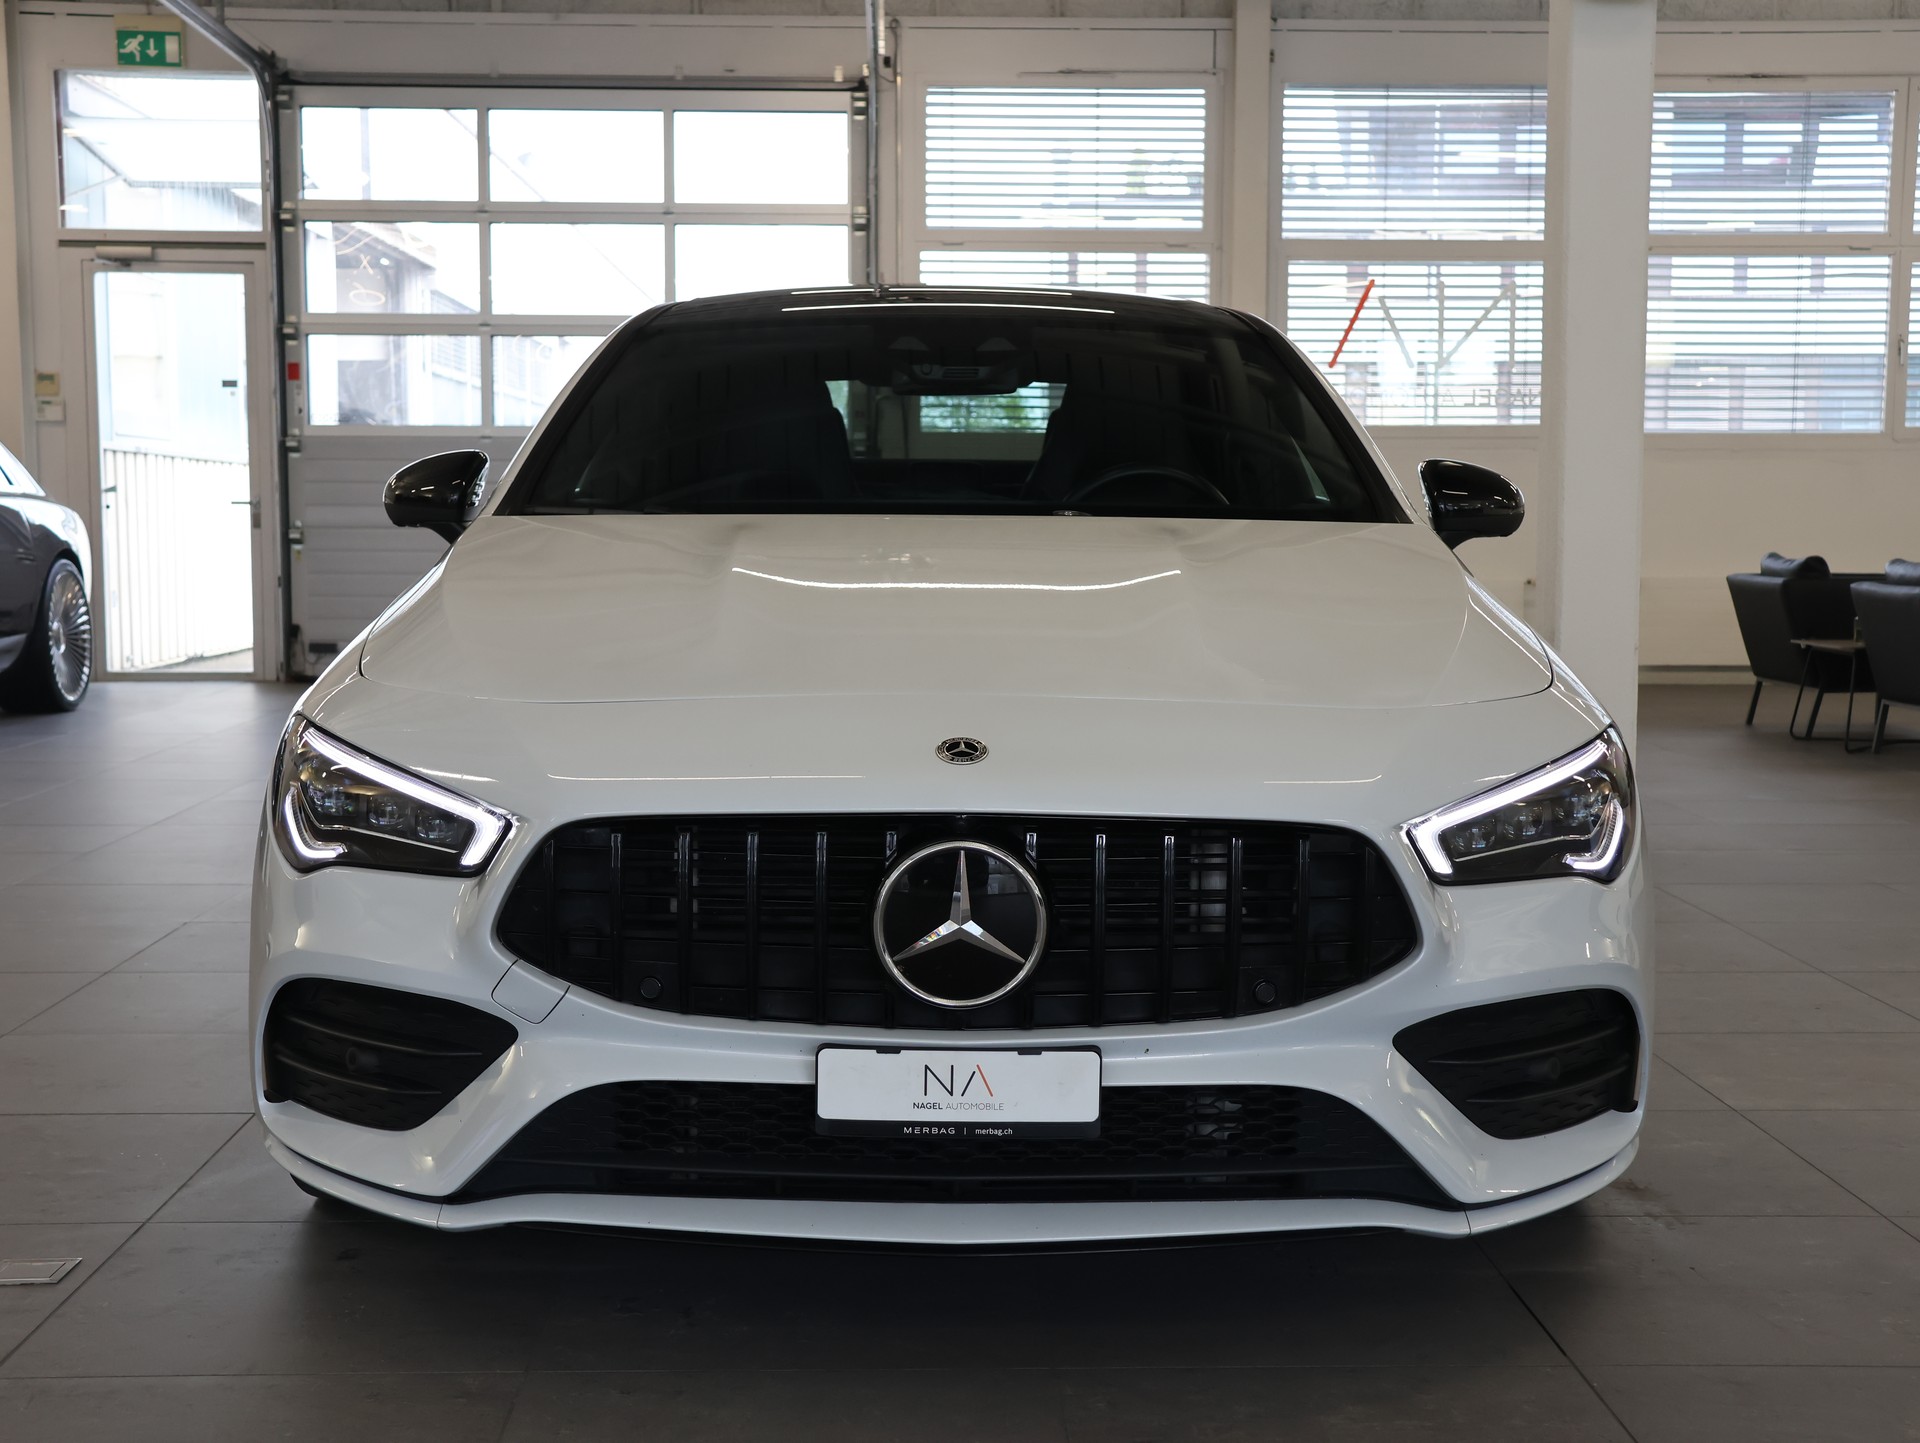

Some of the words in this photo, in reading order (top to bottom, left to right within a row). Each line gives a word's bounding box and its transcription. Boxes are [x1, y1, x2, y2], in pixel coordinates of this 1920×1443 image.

[912, 1102, 943, 1110] NAGEL
[945, 1102, 1005, 1111] AUTOMOBILE
[903, 1126, 956, 1135] MERBAG
[975, 1127, 1013, 1137] merbag.ch
